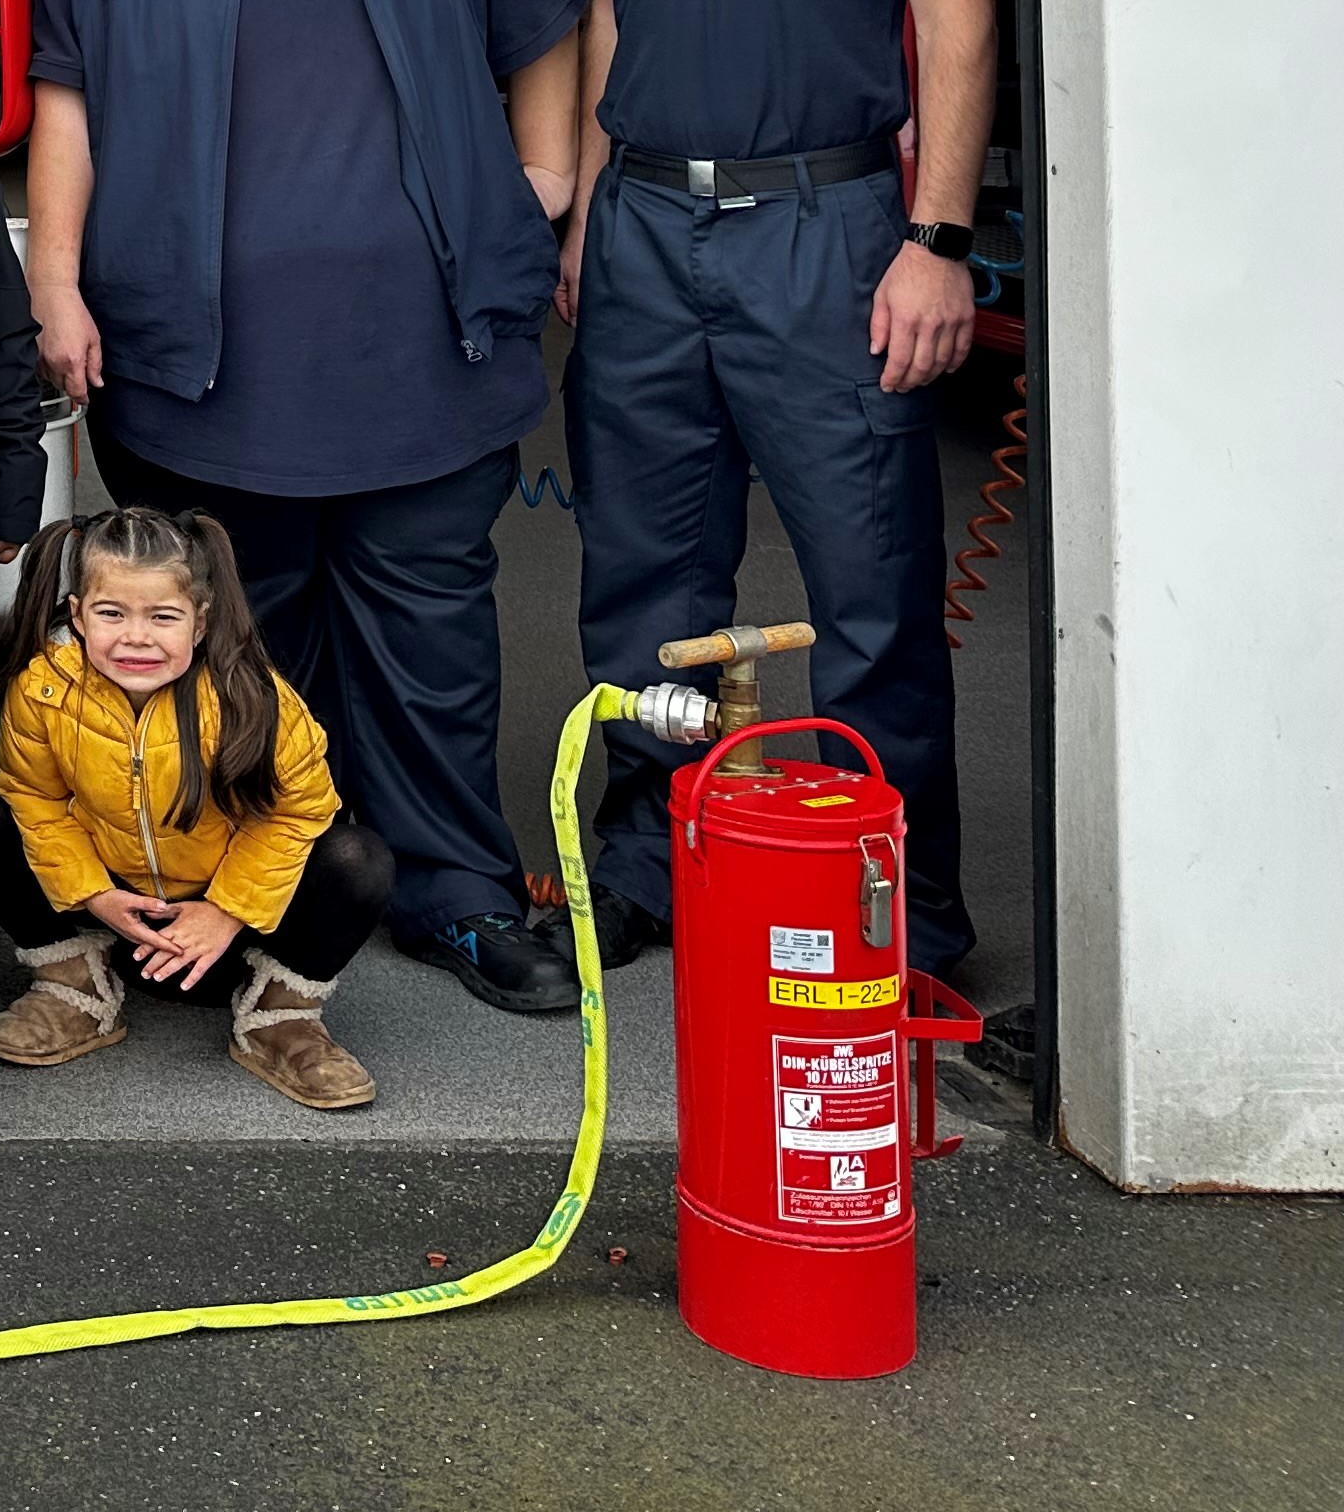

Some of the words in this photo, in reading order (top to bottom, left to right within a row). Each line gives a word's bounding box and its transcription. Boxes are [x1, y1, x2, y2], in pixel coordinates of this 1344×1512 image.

[776, 981, 826, 1005] ERL
[835, 979, 897, 1005] 1-22-1
[782, 1050, 892, 1071] DIN-KÜBELSPRITZE
[805, 1070, 821, 1084] 10
[831, 1068, 879, 1084] WASSER
[849, 1155, 865, 1170] A
